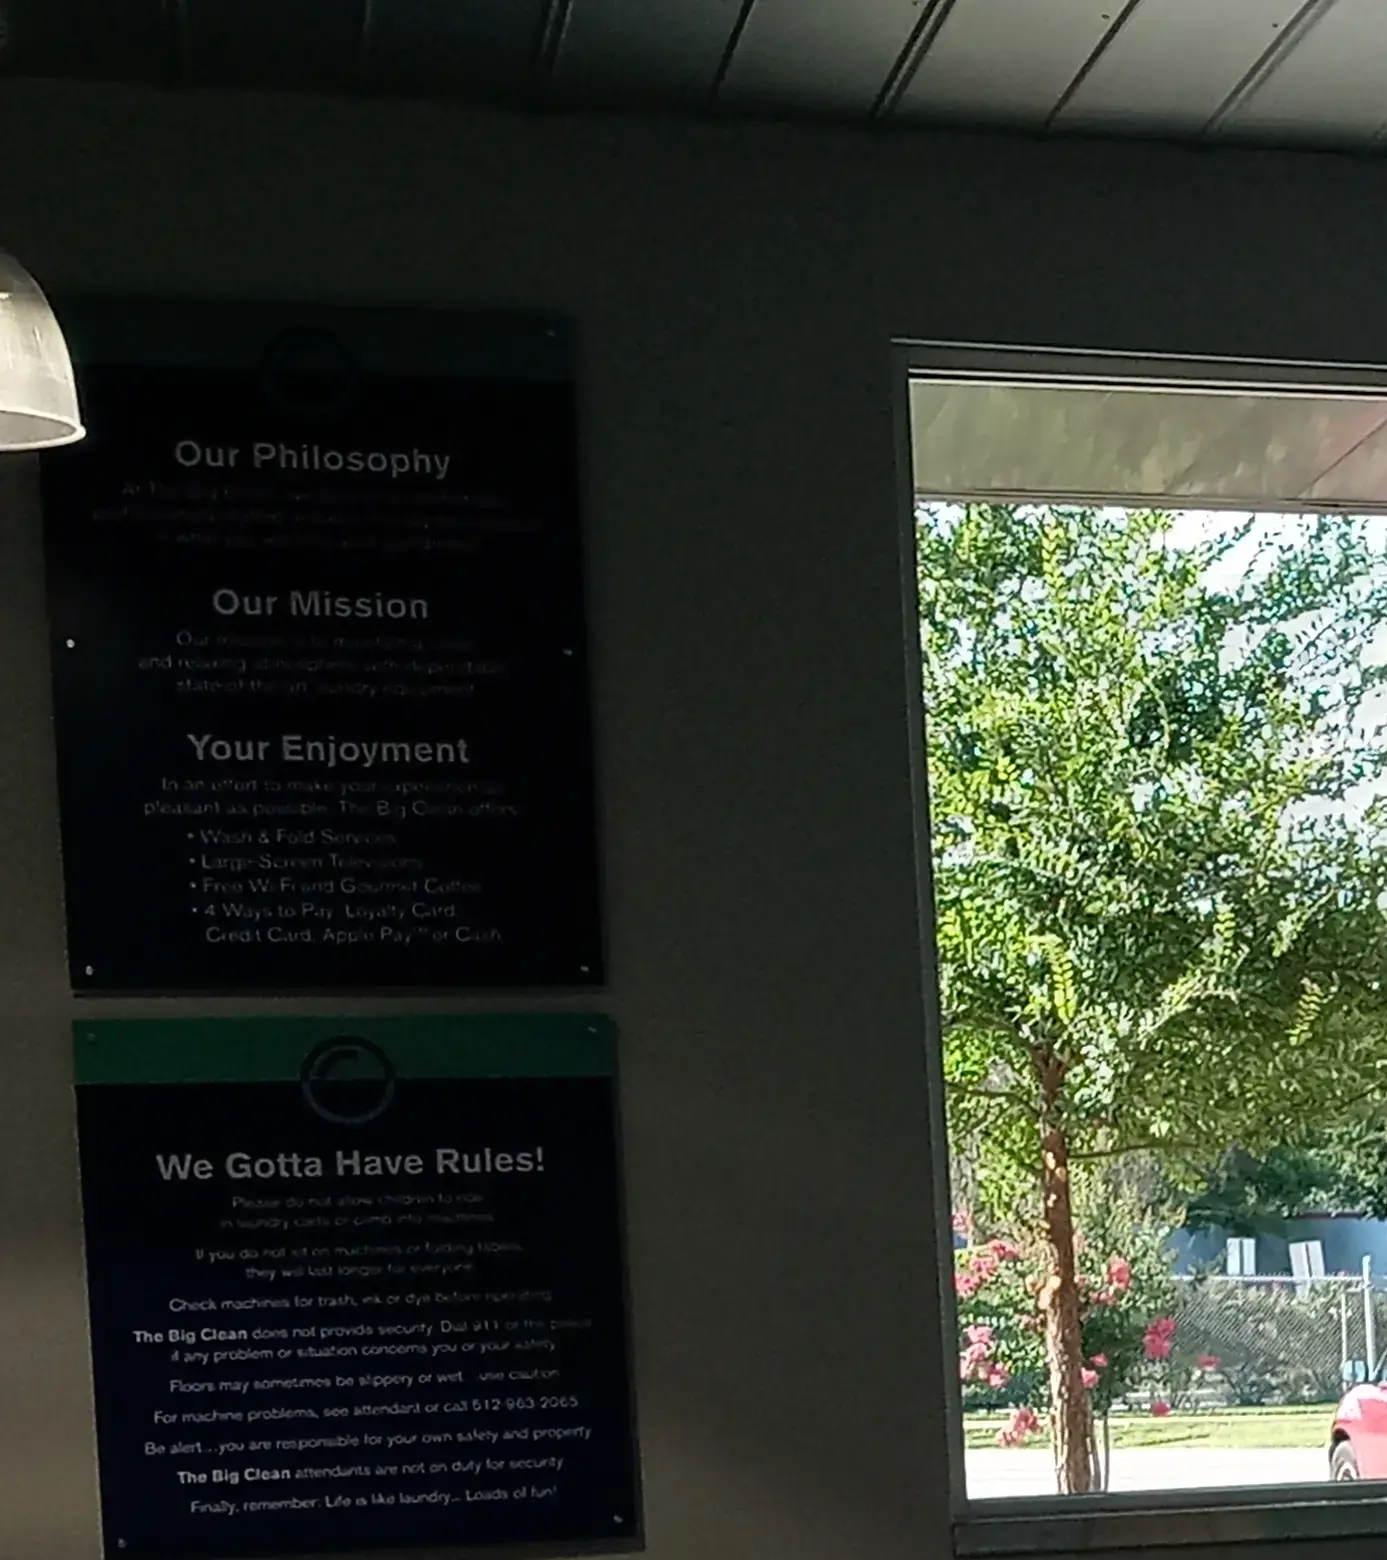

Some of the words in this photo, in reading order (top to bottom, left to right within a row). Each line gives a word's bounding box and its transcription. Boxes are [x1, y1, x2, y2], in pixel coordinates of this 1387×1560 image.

[175, 439, 240, 468] Our
[253, 441, 451, 480] Philosophy
[212, 588, 278, 617] Our
[290, 589, 429, 621] Mission
[186, 733, 270, 762] Your
[281, 733, 470, 767] Enjoyment
[143, 800, 220, 817] pleasant
[200, 828, 252, 844] Wash
[258, 830, 270, 844] &
[276, 828, 314, 844] Fold
[202, 877, 244, 893] Free
[302, 879, 334, 894] and
[424, 877, 483, 894] Coffee
[204, 903, 216, 916] 4
[221, 901, 272, 922] Ways
[277, 903, 296, 918] to
[206, 926, 262, 943] Credit
[323, 926, 374, 945] Apple
[432, 930, 449, 942] or
[455, 926, 501, 942] Cash
[155, 1153, 213, 1181] We
[224, 1151, 323, 1179] Gotta
[335, 1149, 424, 1177] Have
[436, 1146, 545, 1175] Rules!
[169, 1297, 217, 1312] Check
[220, 1297, 290, 1311] machines
[294, 1295, 314, 1307] for
[132, 1329, 164, 1343] The
[167, 1328, 197, 1345] Big
[200, 1327, 248, 1342] Clean
[252, 1326, 288, 1340] does
[292, 1326, 316, 1338] not
[320, 1323, 374, 1340] provide
[184, 1351, 209, 1365] any
[213, 1348, 274, 1364] problem
[277, 1349, 292, 1359] or
[296, 1344, 357, 1358] situation
[361, 1342, 428, 1356] concerns
[432, 1343, 458, 1357] you
[461, 1342, 476, 1351] or
[480, 1341, 510, 1354] your
[169, 1379, 215, 1394] Floors
[219, 1380, 249, 1394] may
[253, 1376, 331, 1390] sometimes
[335, 1375, 354, 1388] be
[358, 1373, 413, 1388] slippery
[418, 1374, 432, 1384] or
[154, 1409, 177, 1424] For
[181, 1409, 244, 1423] machine
[322, 1407, 349, 1417] see
[353, 1402, 421, 1416] attendant
[425, 1403, 440, 1414] or
[443, 1400, 468, 1413] call
[144, 1441, 165, 1456] Be
[248, 1440, 272, 1451] are
[276, 1434, 359, 1451] responsible
[364, 1433, 382, 1445] for
[386, 1434, 418, 1448] your
[422, 1432, 452, 1444] own
[456, 1428, 499, 1443] safety
[502, 1428, 529, 1440] and
[176, 1470, 208, 1484] The
[212, 1468, 240, 1485] Big
[244, 1467, 291, 1481] Clean
[295, 1464, 372, 1478] attendants
[375, 1465, 399, 1476] are
[402, 1462, 425, 1475] not
[429, 1463, 448, 1473] on
[452, 1459, 481, 1475] duty
[485, 1457, 506, 1470] for
[190, 1500, 240, 1515] Finally,
[324, 1494, 351, 1508] Life
[355, 1495, 368, 1506] is
[371, 1491, 396, 1505] like
[465, 1488, 508, 1501] Loads
[512, 1486, 527, 1499] of
